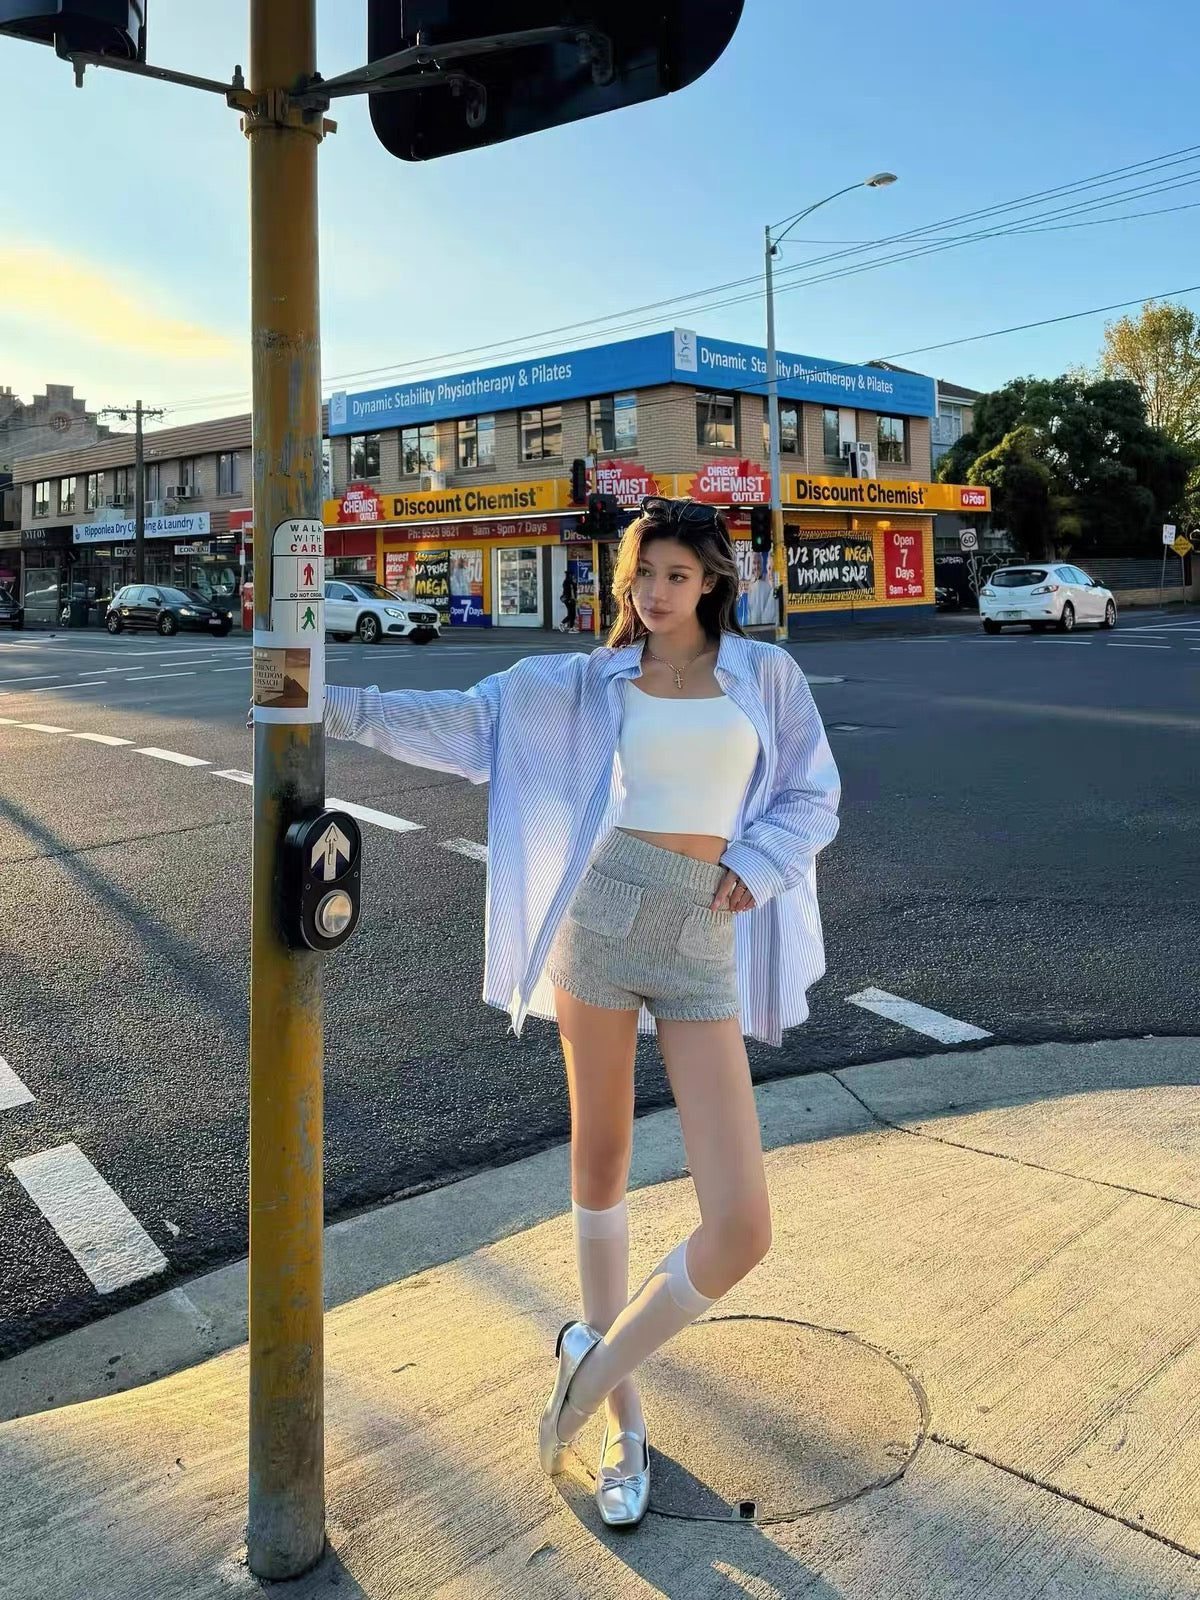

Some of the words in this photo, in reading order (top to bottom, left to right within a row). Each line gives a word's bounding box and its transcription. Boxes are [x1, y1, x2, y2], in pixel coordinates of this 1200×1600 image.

[701, 347, 747, 370] Dynamic
[751, 356, 792, 381] Stality
[793, 363, 857, 391] Physiotherapy
[858, 374, 866, 389] &
[867, 379, 894, 394] Pilates
[352, 393, 393, 417] Dynamic
[394, 387, 436, 406] Stability
[437, 374, 515, 402] Physiotherapy
[518, 368, 528, 387] &
[531, 364, 572, 385] Pilates
[707, 466, 740, 477] DIRECT
[700, 477, 765, 492] CHEMIST
[796, 478, 866, 502] Discount
[867, 483, 924, 505] Chemist
[393, 493, 462, 516] Discount
[464, 488, 537, 511] Chemist
[731, 492, 765, 502] OUTLET
[969, 495, 985, 505] POST
[343, 499, 378, 514] CHEMIST
[360, 512, 379, 521] OUTLET
[84, 523, 115, 538] Ripponlea
[115, 523, 127, 535] Dry
[128, 520, 156, 533] Cling
[157, 519, 164, 529] &
[164, 516, 194, 530] Laundry
[408, 529, 421, 540] Ph:
[472, 525, 490, 536] 9am
[497, 523, 516, 537] 9pm
[517, 522, 523, 533] 7
[525, 521, 548, 535] Days
[564, 529, 591, 540] Direc
[294, 534, 321, 543] WITH
[893, 533, 915, 548] Open
[963, 535, 974, 544] 60
[116, 548, 131, 558] Dry
[290, 543, 322, 553] CARE
[788, 546, 809, 567] 1/2
[813, 544, 841, 566] PRICE
[844, 545, 874, 563] MEGA
[900, 548, 909, 568] 7
[427, 561, 449, 575] PRICE
[581, 567, 589, 578] 7
[797, 565, 839, 586] VITAMIN
[895, 566, 915, 580] Days
[416, 577, 449, 596] MEGA
[889, 584, 904, 595] 9am
[908, 583, 922, 596] 9pm
[450, 607, 465, 617] Open
[460, 599, 471, 622] 7
[469, 607, 484, 617] Days
